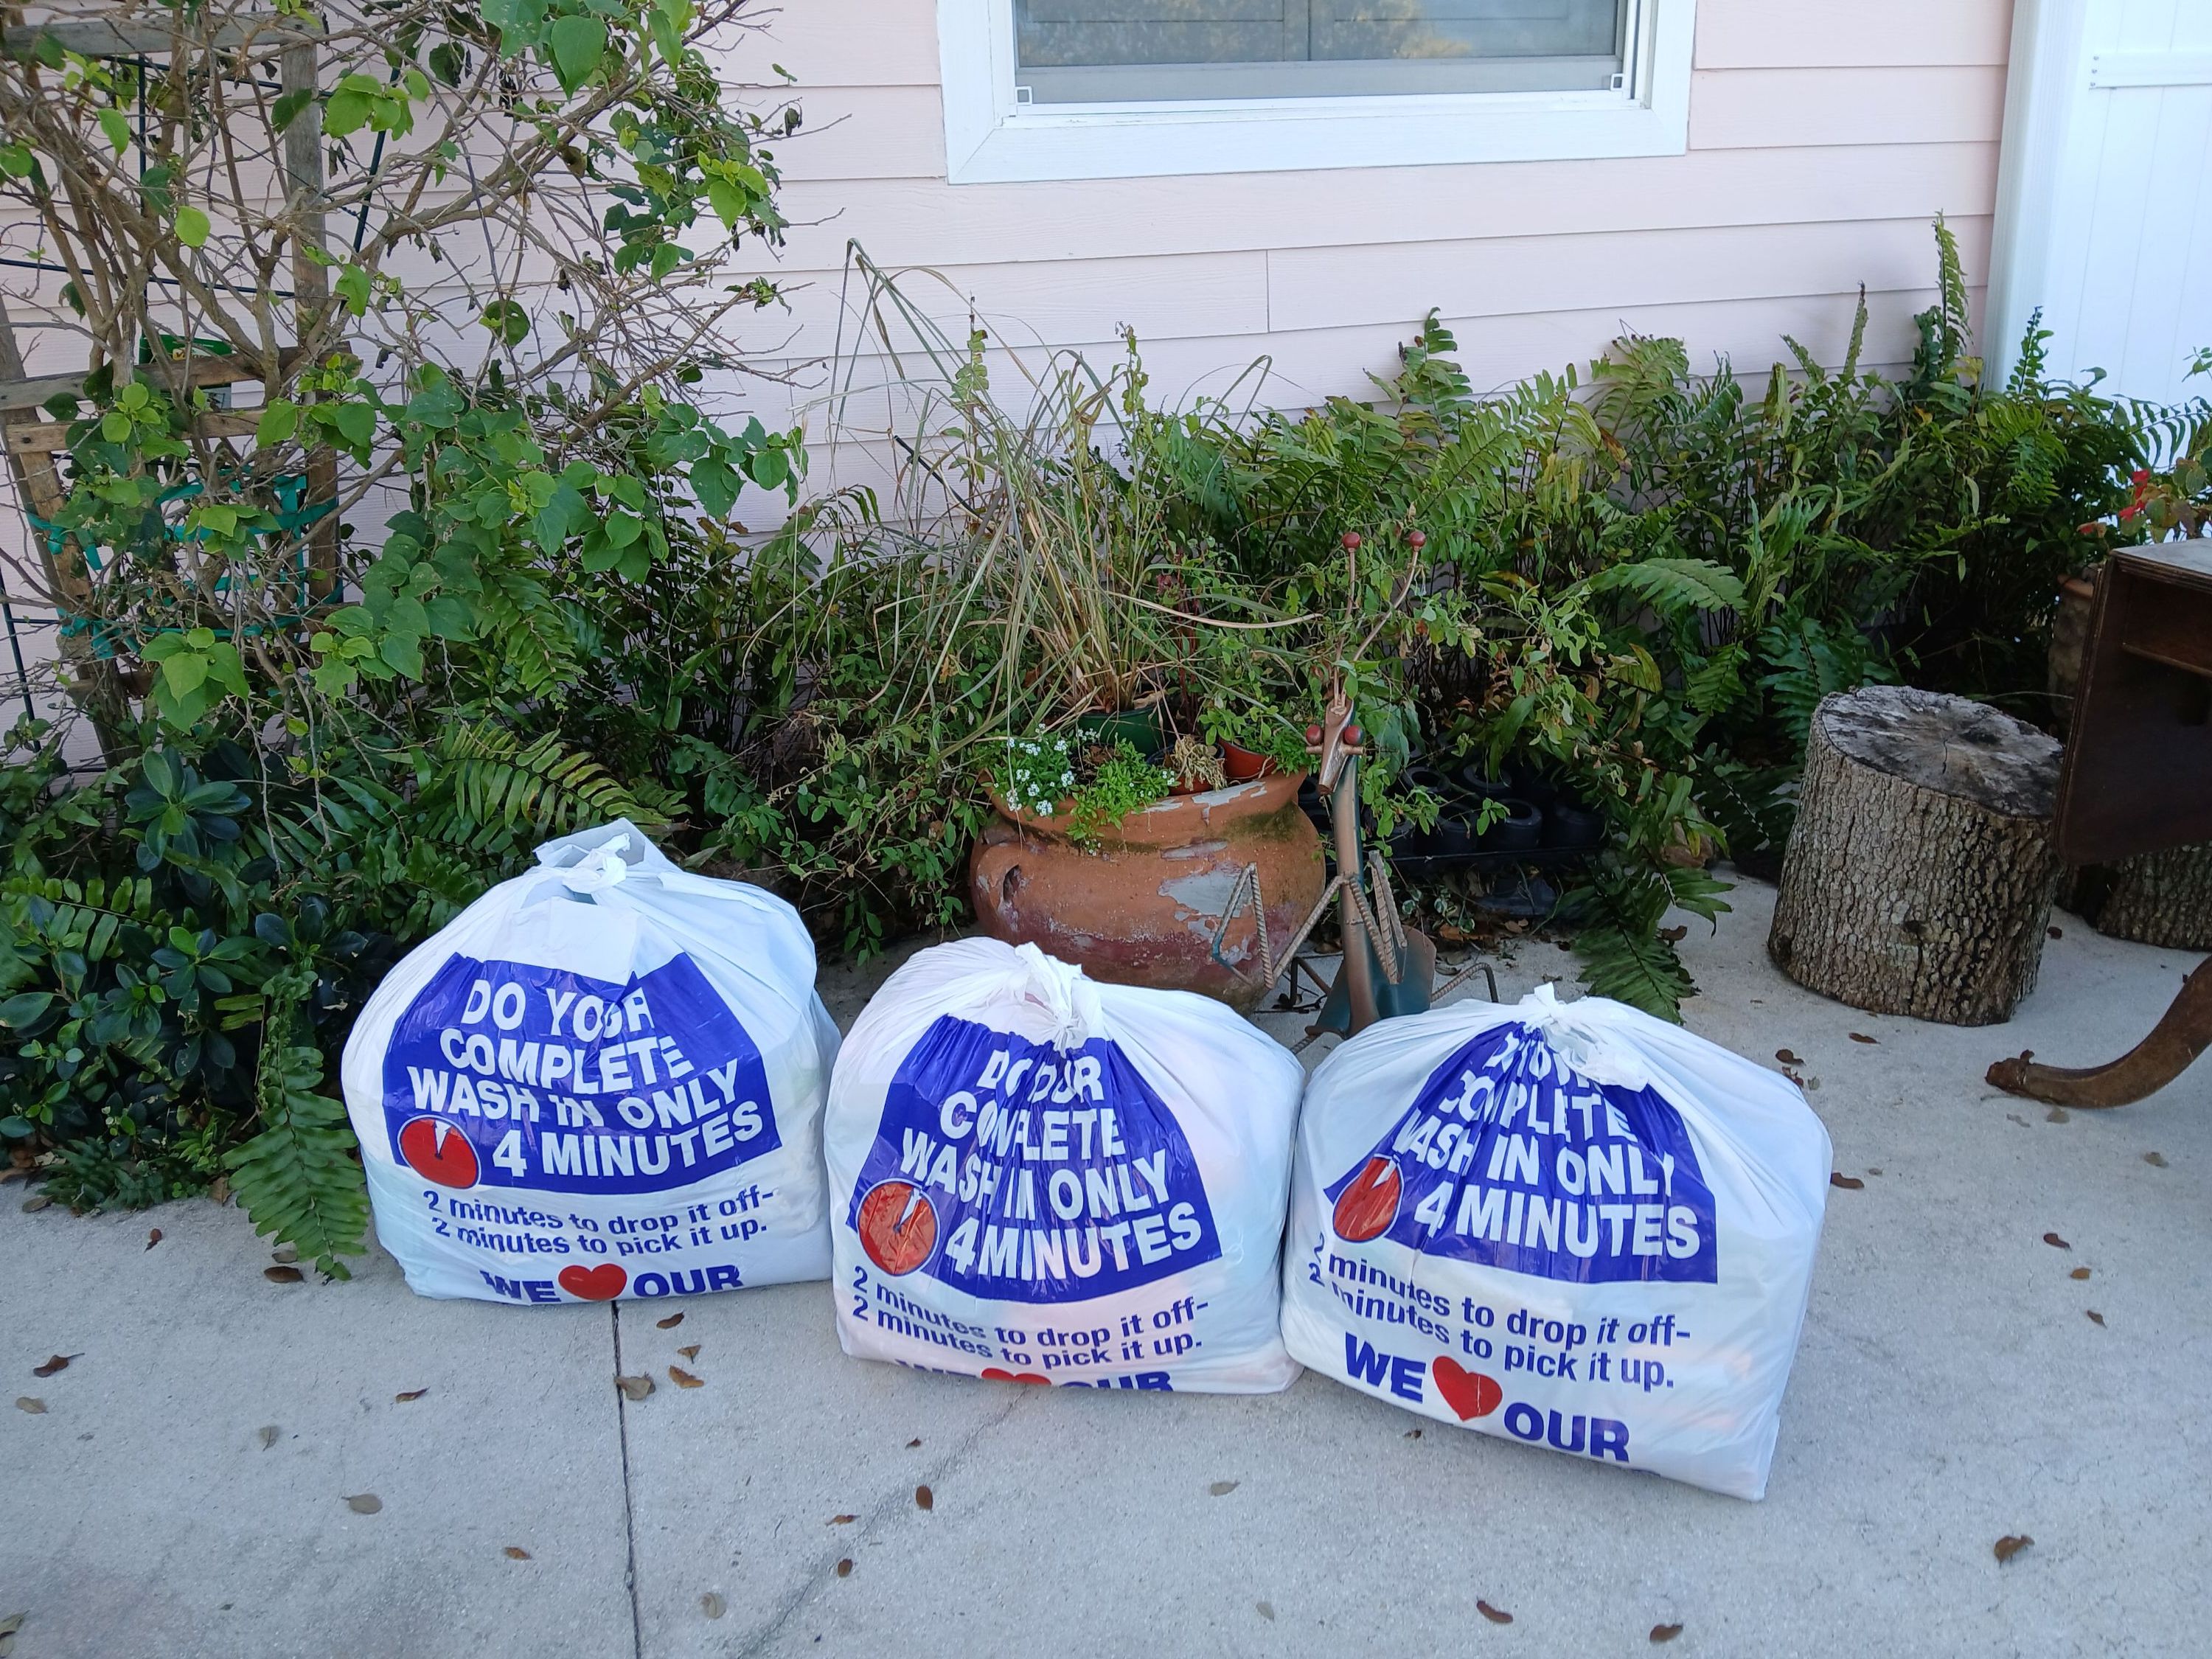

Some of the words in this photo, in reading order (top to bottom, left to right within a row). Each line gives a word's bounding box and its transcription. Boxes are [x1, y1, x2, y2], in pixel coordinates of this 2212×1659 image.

[461, 979, 526, 1030] DO
[407, 1066, 540, 1123] WASH
[548, 1094, 605, 1127] IN
[617, 1058, 738, 1129] ONLY
[442, 1028, 695, 1094] COMPLETE
[493, 1130, 527, 1178] 4
[541, 1101, 763, 1177] MINUTES
[900, 1127, 1004, 1214] WASH
[1049, 1150, 1168, 1221] ONLY
[1486, 1133, 1539, 1186] IN
[1557, 1144, 1674, 1197] ONLY
[423, 1190, 441, 1212] 2
[450, 1197, 563, 1230] minutes
[569, 1211, 598, 1233] to
[608, 1210, 678, 1240] drop
[689, 1202, 711, 1224] it
[718, 1184, 775, 1215] off-
[431, 1217, 451, 1236] 2
[457, 1225, 569, 1255] minutes
[577, 1233, 607, 1254] to
[616, 1234, 681, 1256] pick
[692, 1225, 713, 1247] it
[720, 1219, 768, 1248] up.
[946, 1219, 976, 1274] 4
[978, 1203, 1202, 1281] MINUTES
[1414, 1180, 1454, 1238] 4
[1455, 1184, 1700, 1259] MINUTES
[479, 1270, 562, 1303] WE
[633, 1264, 744, 1298] OUR
[852, 1266, 869, 1293] 2
[876, 1283, 986, 1339] minutes
[995, 1326, 1026, 1347] to
[1036, 1325, 1110, 1354] drop
[1120, 1315, 1144, 1335] it
[1153, 1296, 1209, 1328] off-
[1329, 1253, 1450, 1316] minutes
[1462, 1296, 1495, 1327] to
[1506, 1307, 1586, 1352] drop
[1597, 1315, 1620, 1340] it
[1627, 1315, 1691, 1346] off-
[852, 1293, 869, 1321] 2
[877, 1309, 992, 1358] minutes
[1001, 1347, 1032, 1367] to
[1044, 1346, 1113, 1370] pick
[1121, 1340, 1144, 1361] it
[1155, 1329, 1202, 1358] up.
[1309, 1262, 1325, 1287] 2
[1332, 1281, 1450, 1343] minutes
[1461, 1329, 1492, 1359] to
[1505, 1344, 1576, 1382] pick
[1589, 1352, 1611, 1382] it
[1621, 1357, 1674, 1390] up.
[1345, 1332, 1426, 1403] WE
[1503, 1401, 1630, 1464] OUR
